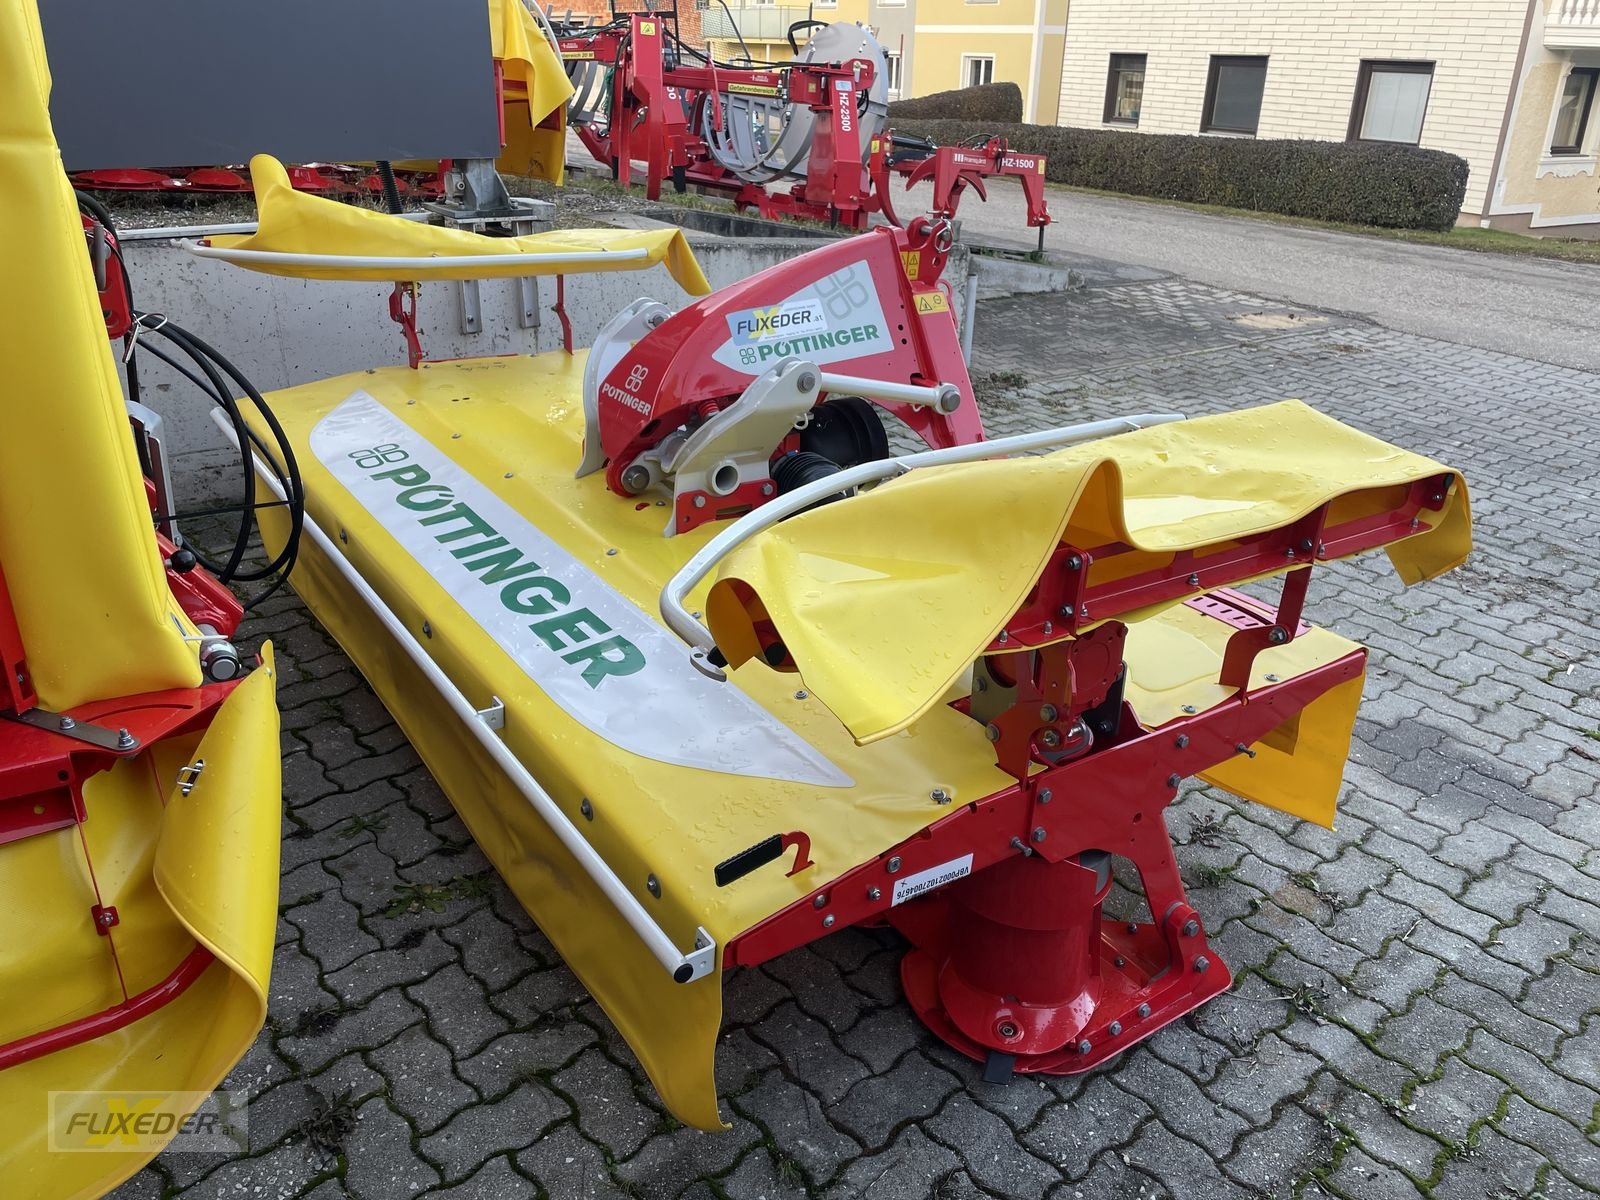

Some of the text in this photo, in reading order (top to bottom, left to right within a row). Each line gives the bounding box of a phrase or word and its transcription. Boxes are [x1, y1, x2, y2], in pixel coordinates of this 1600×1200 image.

[839, 92, 851, 131] HZ-2300
[1001, 157, 1034, 169] HZ-1500
[369, 463, 647, 690] PÖTTINGER
